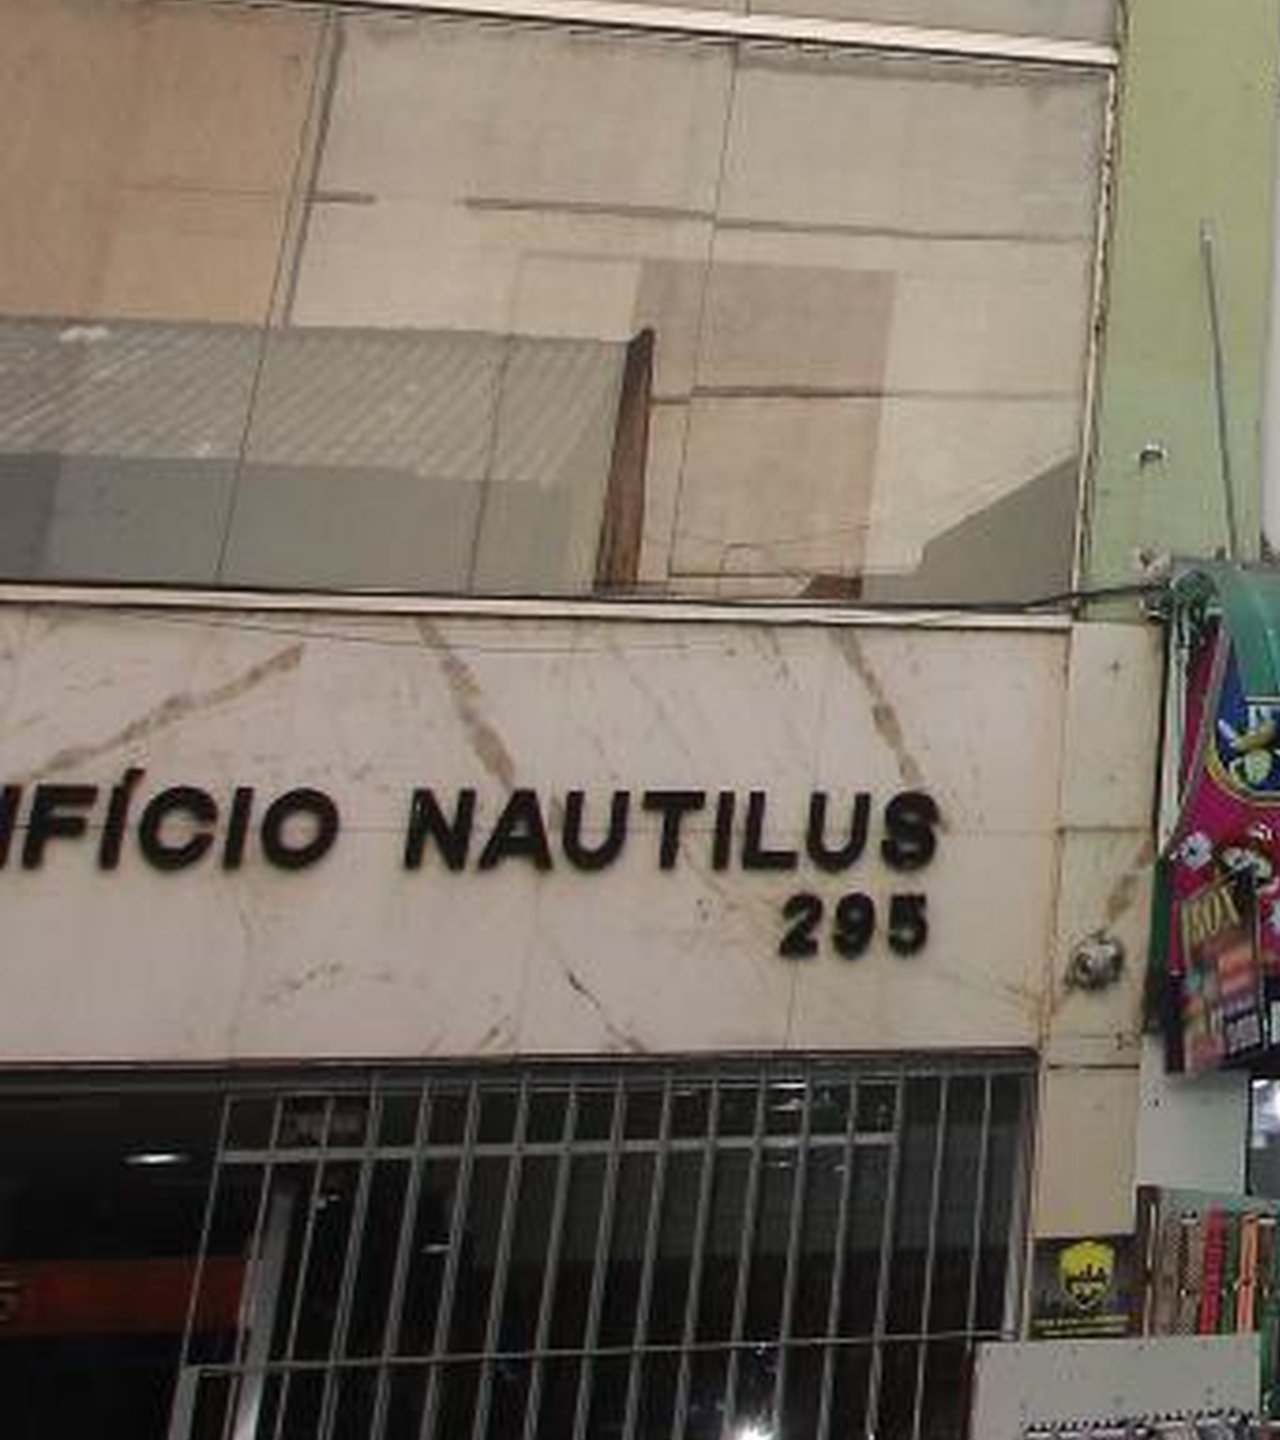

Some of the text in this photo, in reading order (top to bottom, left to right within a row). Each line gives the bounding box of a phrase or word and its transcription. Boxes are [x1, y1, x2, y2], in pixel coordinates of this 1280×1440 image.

[0, 767, 940, 875] IFÍCIO NAUTILUS
[779, 891, 929, 957] 295
